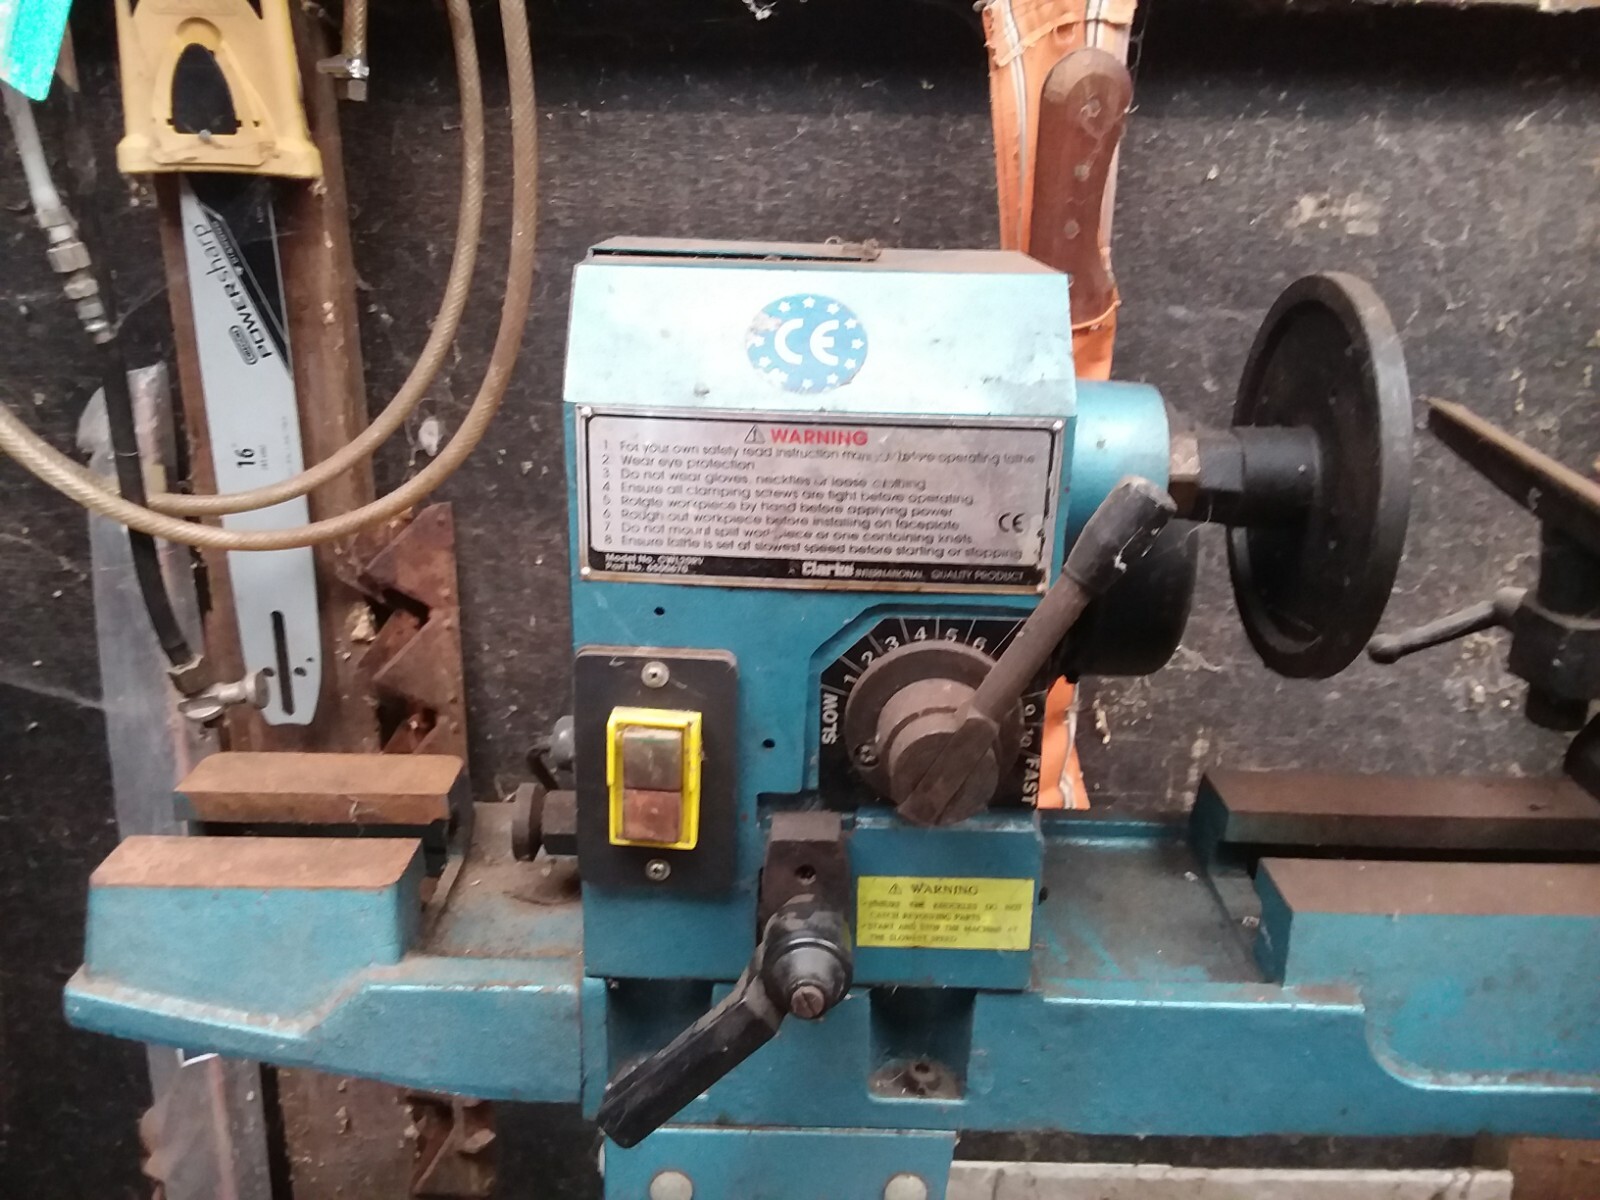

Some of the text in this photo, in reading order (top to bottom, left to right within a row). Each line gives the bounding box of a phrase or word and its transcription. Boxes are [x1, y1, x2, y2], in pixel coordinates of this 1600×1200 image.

[774, 318, 839, 366] CE
[770, 428, 868, 446] WARNING
[620, 440, 639, 452] For
[642, 443, 669, 455] your
[673, 444, 699, 454] own
[703, 443, 739, 458] safety
[742, 446, 771, 457] read
[775, 447, 838, 459] instruction
[939, 450, 999, 467] operating
[1003, 452, 1034, 465] lathe
[602, 454, 754, 473] 2 Wear eye protection
[602, 467, 609, 478] 3
[620, 468, 639, 479] Do
[643, 469, 664, 480] not
[669, 472, 700, 482] wear
[755, 473, 810, 487] neckties
[831, 476, 867, 488] loose
[602, 481, 974, 507] 4 Ensure all clamping screws are tight before operating
[740, 501, 757, 513] by
[760, 502, 796, 513] hand
[800, 503, 843, 513] before
[847, 503, 907, 519] applying
[911, 506, 952, 520] power
[603, 509, 610, 519] 6
[667, 512, 688, 521] out
[693, 512, 761, 526] workpiece
[765, 515, 809, 528] before
[812, 517, 870, 530] installing
[874, 518, 890, 529] on
[895, 517, 959, 533] faceplate
[621, 522, 639, 532] Do
[643, 523, 664, 533] not
[668, 524, 710, 536] mount
[816, 530, 829, 539] or
[832, 531, 858, 541] one
[862, 530, 933, 546] containing
[938, 533, 972, 544] knots
[604, 534, 1022, 561] 8 Ensure lathe is set at slowest speed before starting or stopping
[801, 561, 854, 577] Clarke
[930, 569, 972, 581] QUALITY
[974, 570, 1024, 581] PRODUCT
[914, 626, 927, 641] 4
[945, 628, 959, 643] 5
[885, 636, 900, 651] 3
[972, 636, 987, 651] 6
[861, 651, 876, 666] 2
[844, 673, 858, 684] 1
[821, 692, 839, 745] SLOW
[1021, 758, 1040, 806] FAST
[911, 883, 979, 895] WARNING
